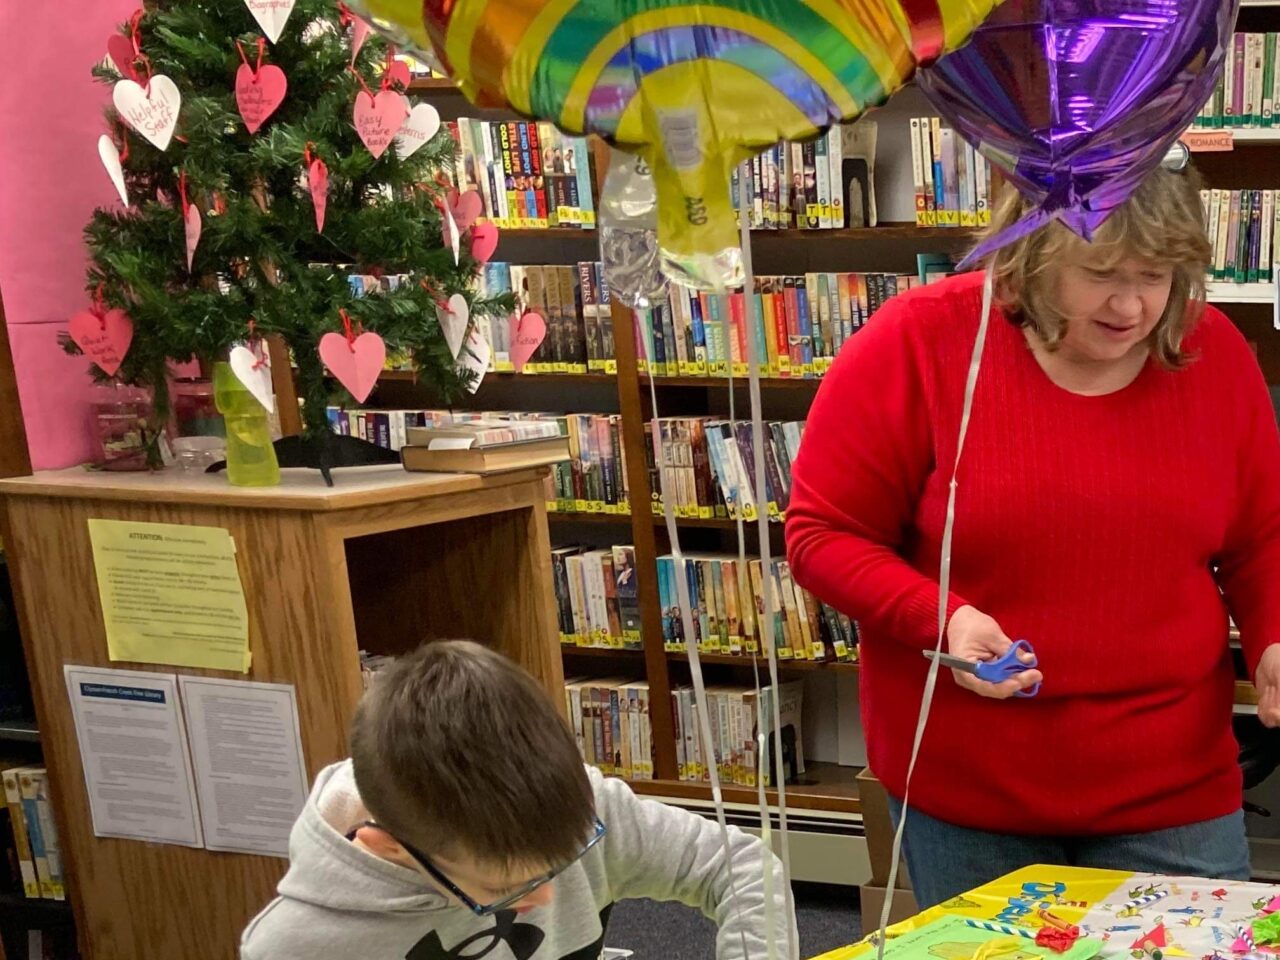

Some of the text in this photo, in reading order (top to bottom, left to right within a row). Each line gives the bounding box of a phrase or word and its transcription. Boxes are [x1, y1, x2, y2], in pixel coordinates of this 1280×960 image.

[508, 123, 516, 149] STILL
[1190, 138, 1231, 147] ROMANCE
[500, 124, 512, 175] COLD SHOT
[522, 150, 531, 175] SPOT
[581, 267, 592, 303] RIVERS
